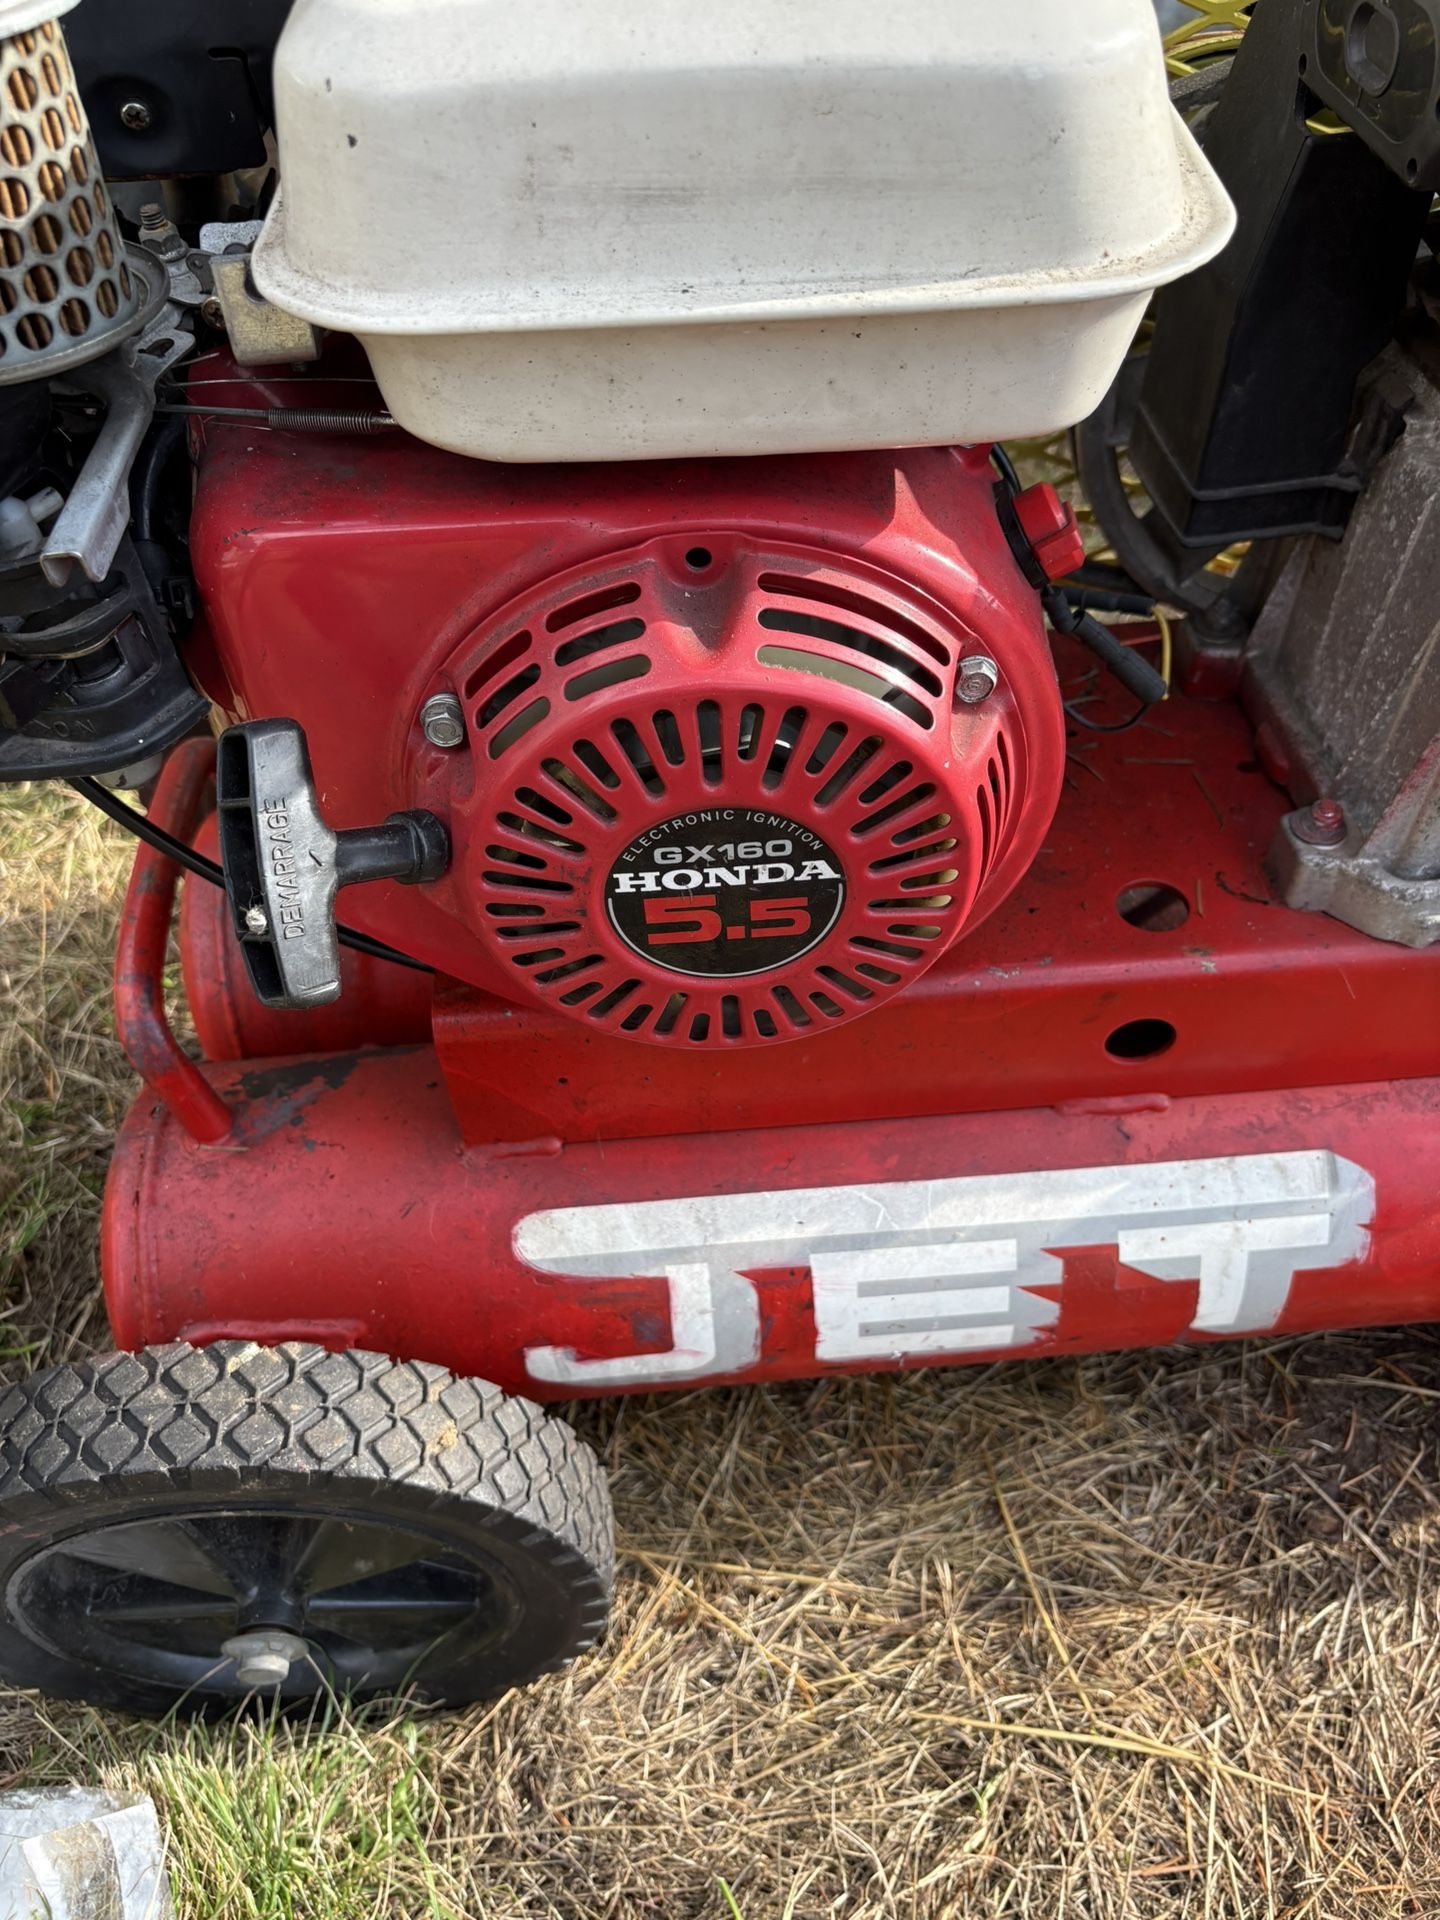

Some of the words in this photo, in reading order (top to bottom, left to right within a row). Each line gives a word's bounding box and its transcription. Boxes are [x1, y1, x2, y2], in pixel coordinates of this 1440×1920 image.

[622, 809, 735, 863] ELECTRONIC
[746, 811, 824, 851] IGNITION
[653, 839, 794, 865] GX160
[263, 797, 307, 940] DEMARRAGE
[612, 859, 842, 893] HONDA
[642, 894, 812, 945] 5.5
[512, 1149, 1376, 1387] JET
